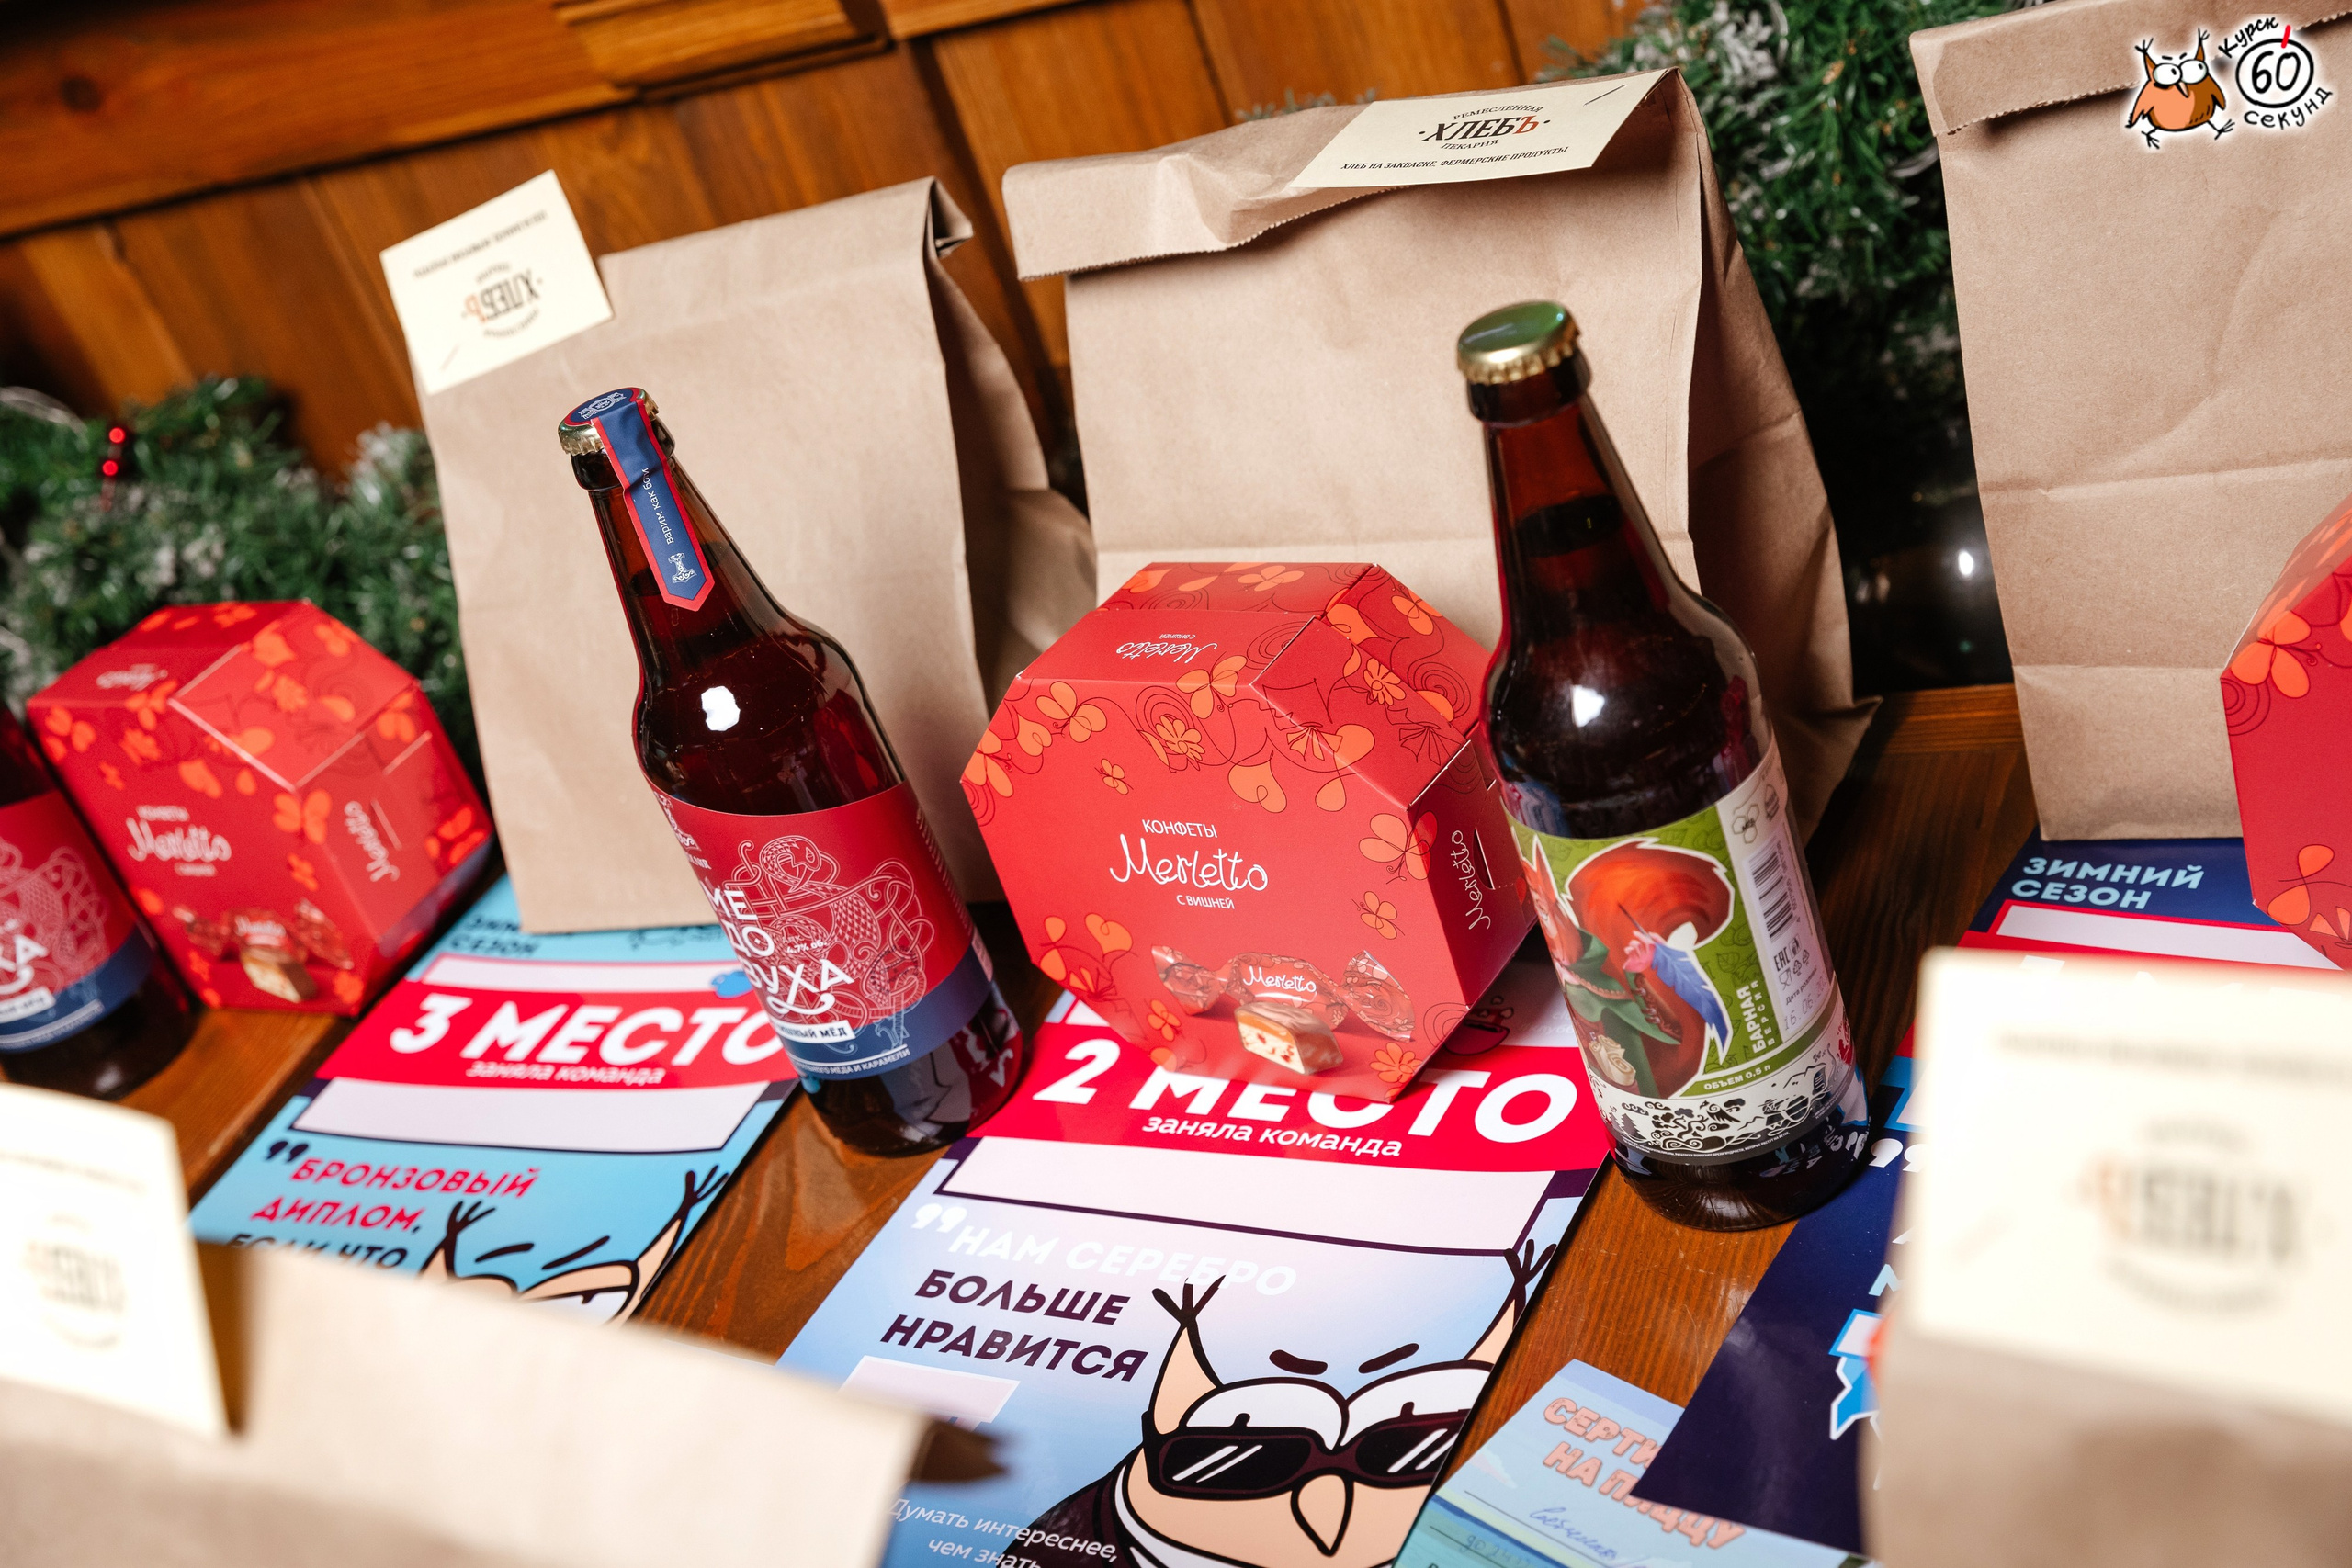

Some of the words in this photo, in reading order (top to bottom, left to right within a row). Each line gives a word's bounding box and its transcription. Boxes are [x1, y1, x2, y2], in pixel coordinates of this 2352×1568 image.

[1453, 104, 1545, 121] РЕМЕСЛЕННАЯ
[1421, 115, 1540, 142] ХЛЕБЪ
[1340, 162, 1368, 170] ХЛЕБ
[1368, 162, 1384, 170] НА
[1440, 153, 1511, 166] ФЕРМЕРСКИЕ
[1510, 145, 1569, 160] ПРОДУКТЫ
[1441, 140, 1499, 151] ПЕКАРИЯ
[647, 489, 663, 511] как
[656, 511, 674, 545] варим
[1116, 642, 1218, 663] Merletto
[1142, 819, 1218, 840] КОНФЕТЫ
[1109, 833, 1269, 892] Merletto
[2023, 857, 2205, 890] ЗИМНИЙ
[1451, 829, 1492, 931] Merletto
[2010, 880, 2152, 910] СЕЗОН
[1176, 894, 1186, 906] С
[1187, 895, 1236, 910] ВИШНЕЙ
[1243, 965, 1317, 995] Merletto
[390, 993, 473, 1054] 3
[459, 1001, 783, 1067] МЕСТО
[819, 1027, 848, 1039] МЁД
[1736, 985, 1767, 1054] БАРНАЯ
[466, 1060, 551, 1082] заняла
[553, 1062, 667, 1085] команда
[1703, 1076, 1744, 1090] ОБЪЕМ
[1745, 1067, 1762, 1079] 0.5
[1033, 1040, 1121, 1104] 2
[1128, 1069, 1578, 1144] МЕСТО
[1142, 1115, 1251, 1143] заняла
[1258, 1126, 1403, 1157] команда
[250, 1196, 426, 1235] ДИПЛОМ,
[1064, 1239, 1297, 1296] СЕРЕБРО
[914, 1269, 1132, 1327] БОЛЬШЕ
[880, 1314, 1150, 1383] НРАВИТСЯ
[1543, 1441, 1603, 1487] НА
[1598, 1469, 1746, 1551] ПЦЦУ
[889, 1498, 969, 1529] Думать
[973, 1518, 1119, 1563] интереснее,
[928, 1538, 973, 1559] чем
